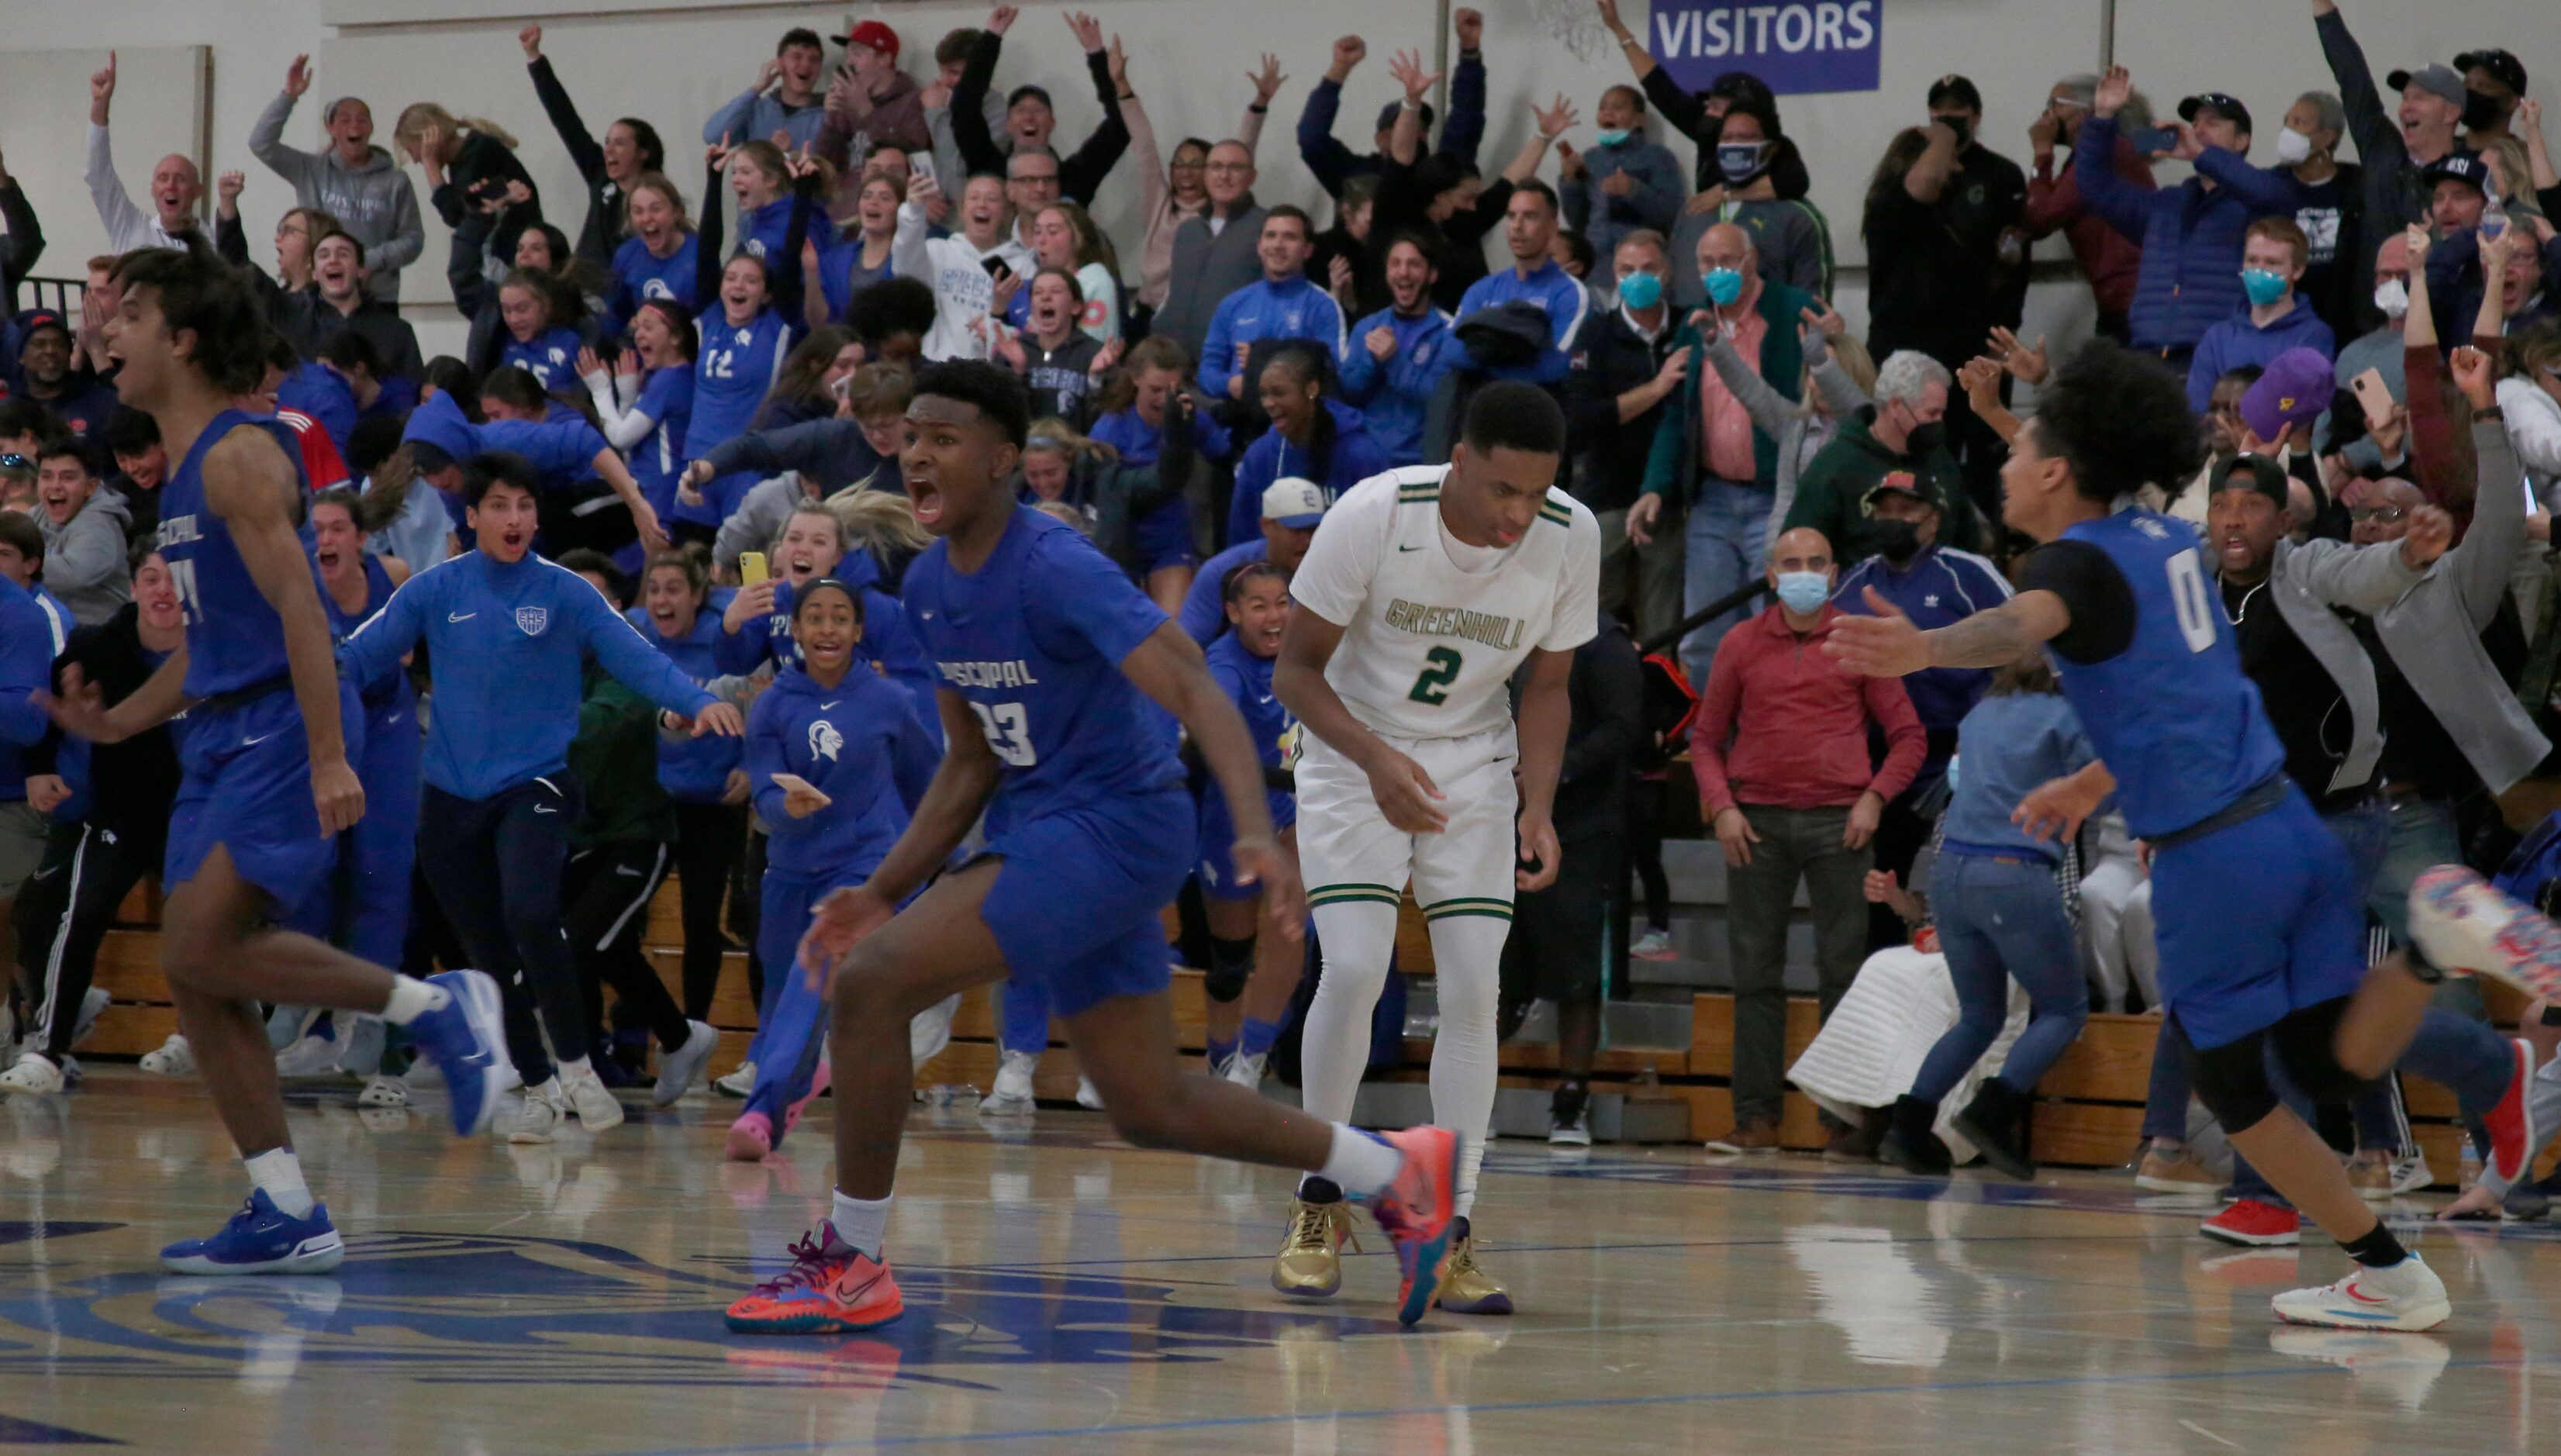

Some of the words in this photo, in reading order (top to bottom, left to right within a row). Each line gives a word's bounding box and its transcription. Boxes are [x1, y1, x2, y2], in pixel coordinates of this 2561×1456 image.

[1656, 1, 1873, 58] VISITORS
[706, 349, 733, 378] 12
[1386, 599, 1524, 651] GREENHILL
[2165, 547, 2218, 654] 0
[1409, 645, 1463, 707] 2
